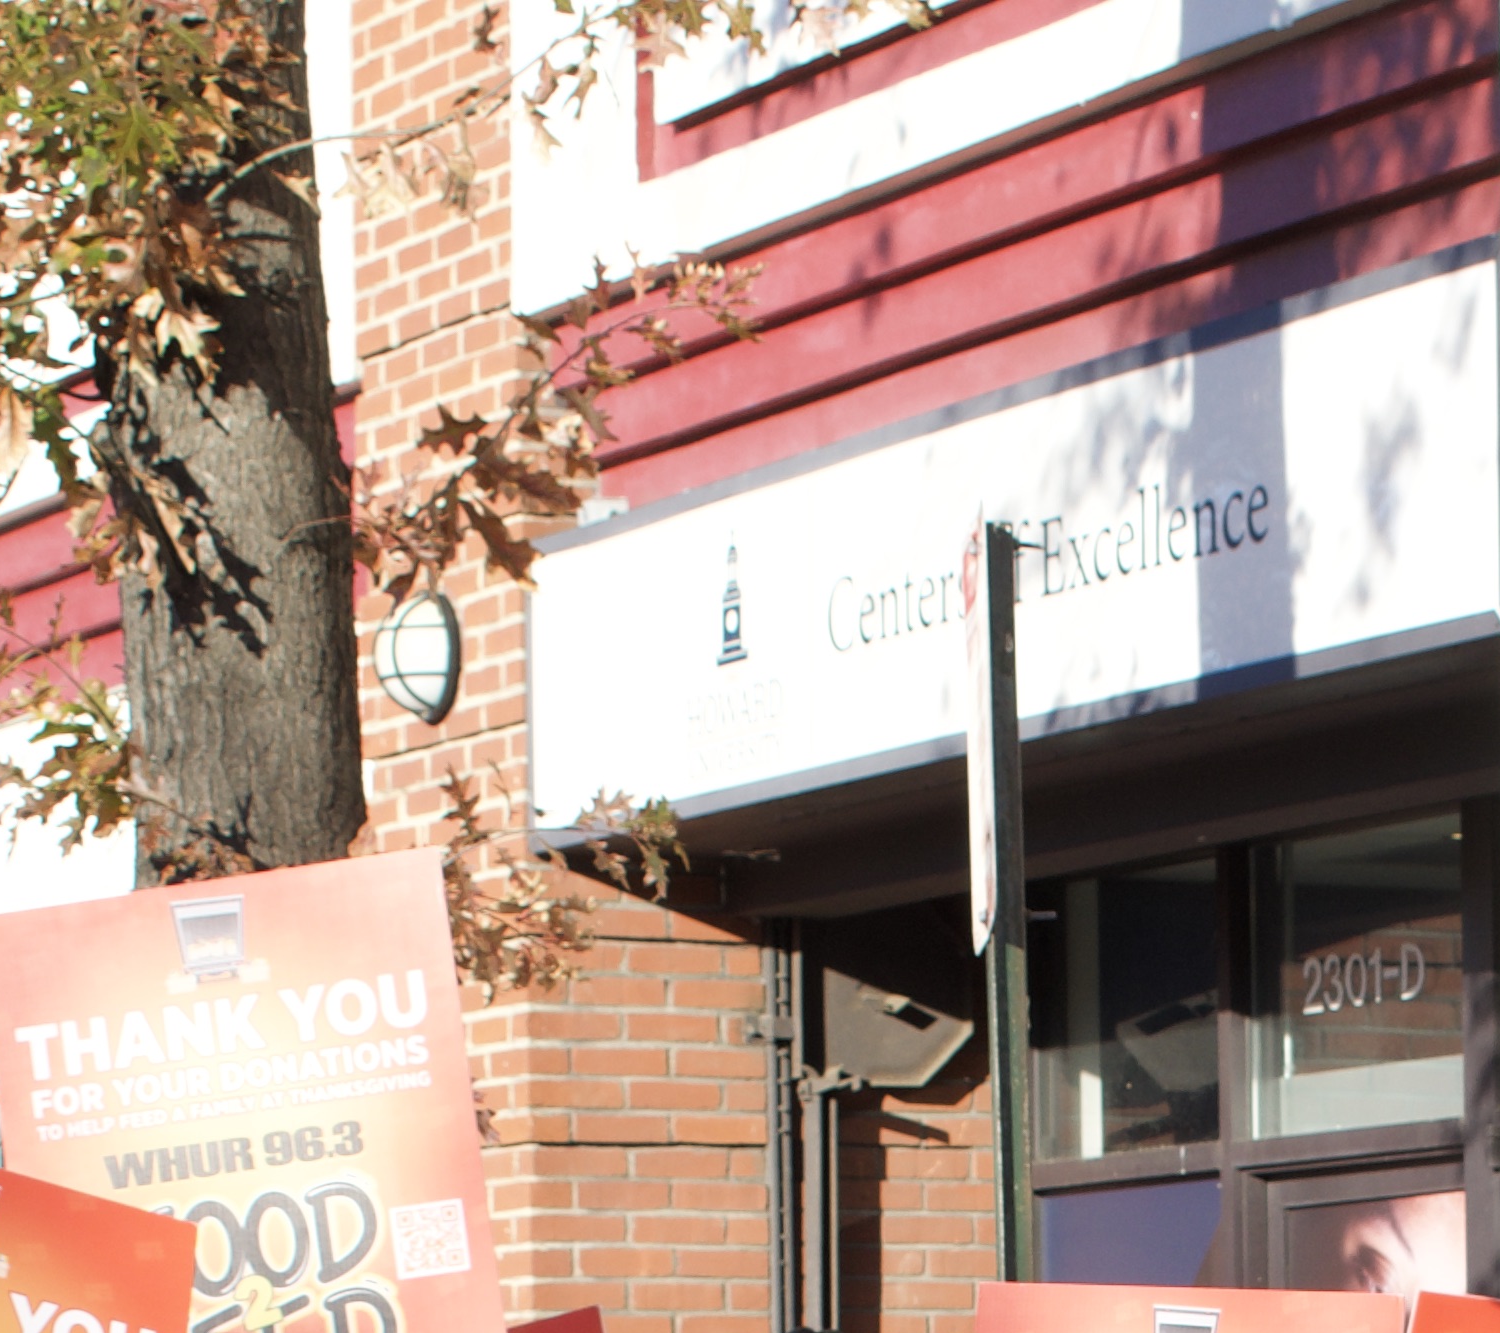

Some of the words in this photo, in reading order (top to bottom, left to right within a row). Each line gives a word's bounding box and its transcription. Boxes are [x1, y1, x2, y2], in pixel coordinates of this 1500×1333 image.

[1039, 483, 1269, 598] Excellence
[12, 991, 266, 1082] THANK
[274, 966, 428, 1043] YOU
[1302, 942, 1426, 1016] 2301-D
[29, 1080, 105, 1120] FOR
[108, 1065, 212, 1108] YOUR
[216, 1033, 430, 1093] DONATIONS
[102, 1134, 260, 1192] WHUR
[260, 1118, 366, 1169] 96.3
[154, 1177, 380, 1300] OOD
